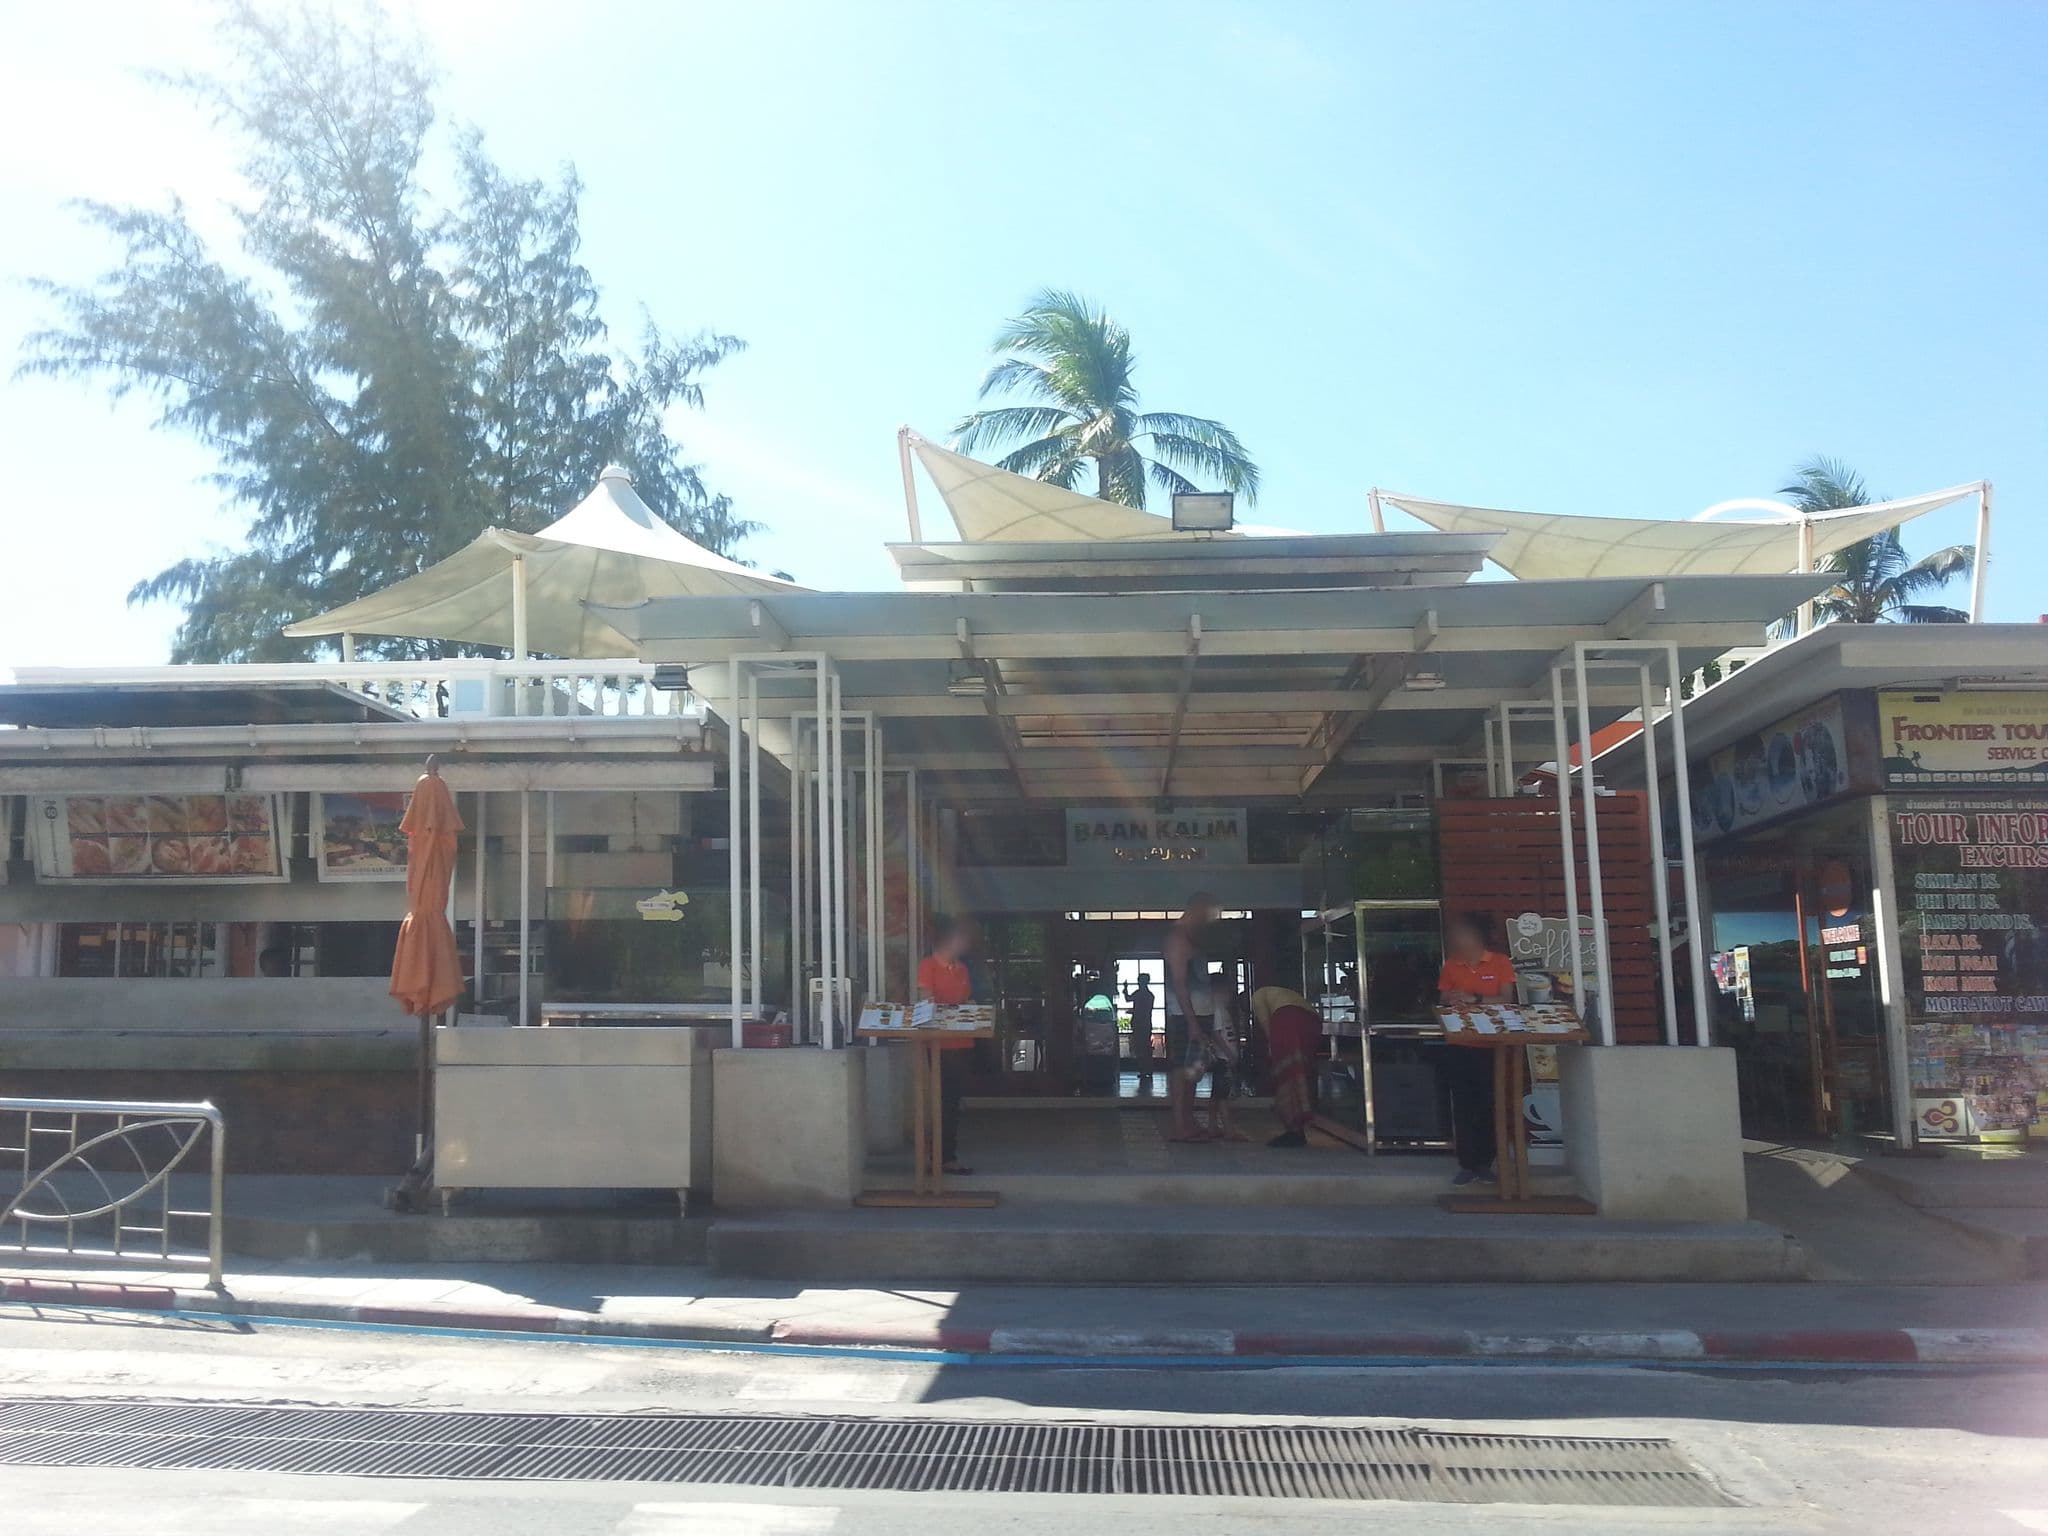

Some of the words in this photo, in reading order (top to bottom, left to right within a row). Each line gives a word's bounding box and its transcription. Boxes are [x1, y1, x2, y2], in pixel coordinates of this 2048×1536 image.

[1892, 716, 1996, 741] FRONTIER
[2002, 723, 2048, 741] TOU
[1988, 747, 2036, 760] SERVICE
[1073, 822, 1148, 842] BAAN
[1156, 819, 1239, 841] KALIM
[1897, 813, 1969, 844] TOUR
[1914, 872, 1978, 889] SIMILAN
[1915, 893, 1945, 910] PHI
[1946, 893, 1977, 910] PHI
[1925, 996, 2013, 1013] MORRAKOT
